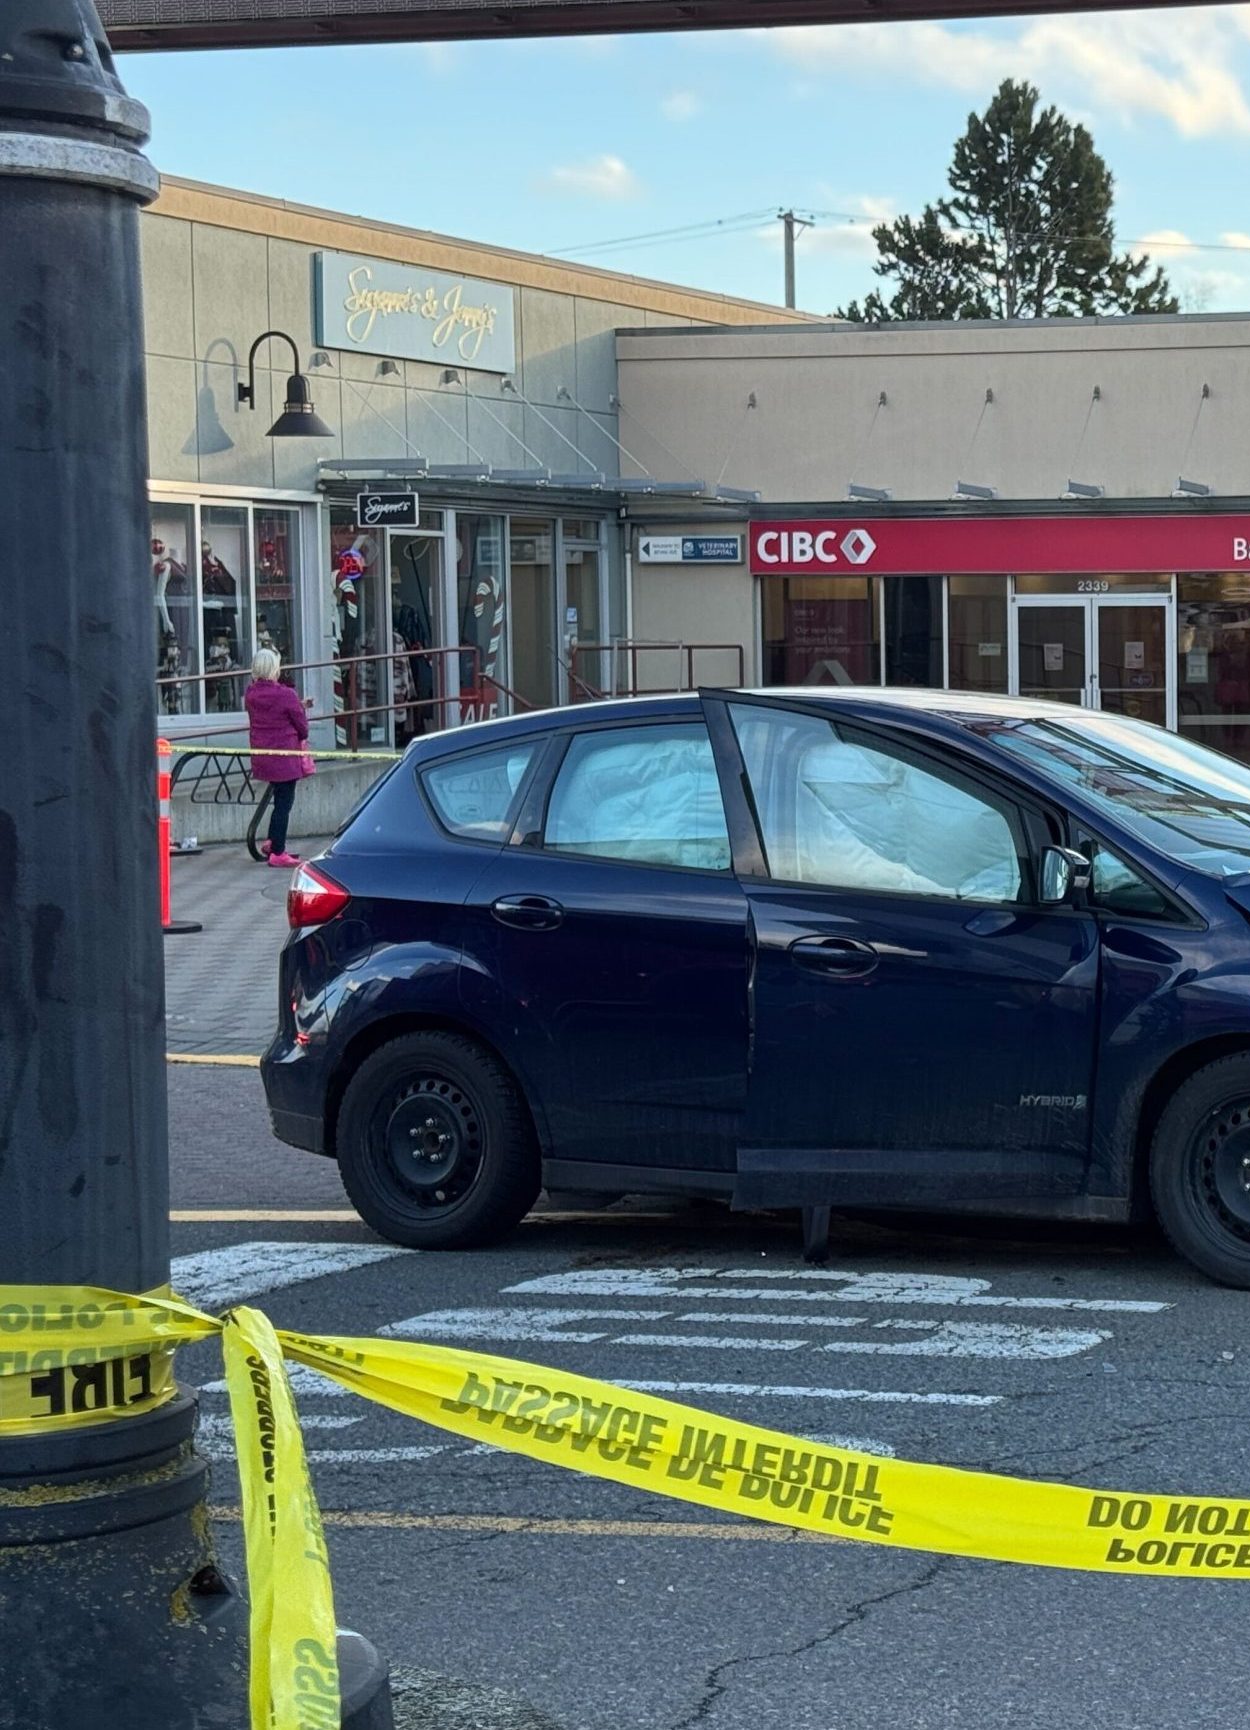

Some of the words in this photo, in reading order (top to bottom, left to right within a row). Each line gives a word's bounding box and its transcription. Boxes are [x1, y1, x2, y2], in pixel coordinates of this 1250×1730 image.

[698, 542, 738, 551] VETERINARY
[702, 548, 735, 557] HOSPITAL
[757, 530, 838, 564] CIBC
[1077, 580, 1109, 593] 2339
[458, 703, 498, 727] ALE
[1018, 1093, 1075, 1107] HYBRID
